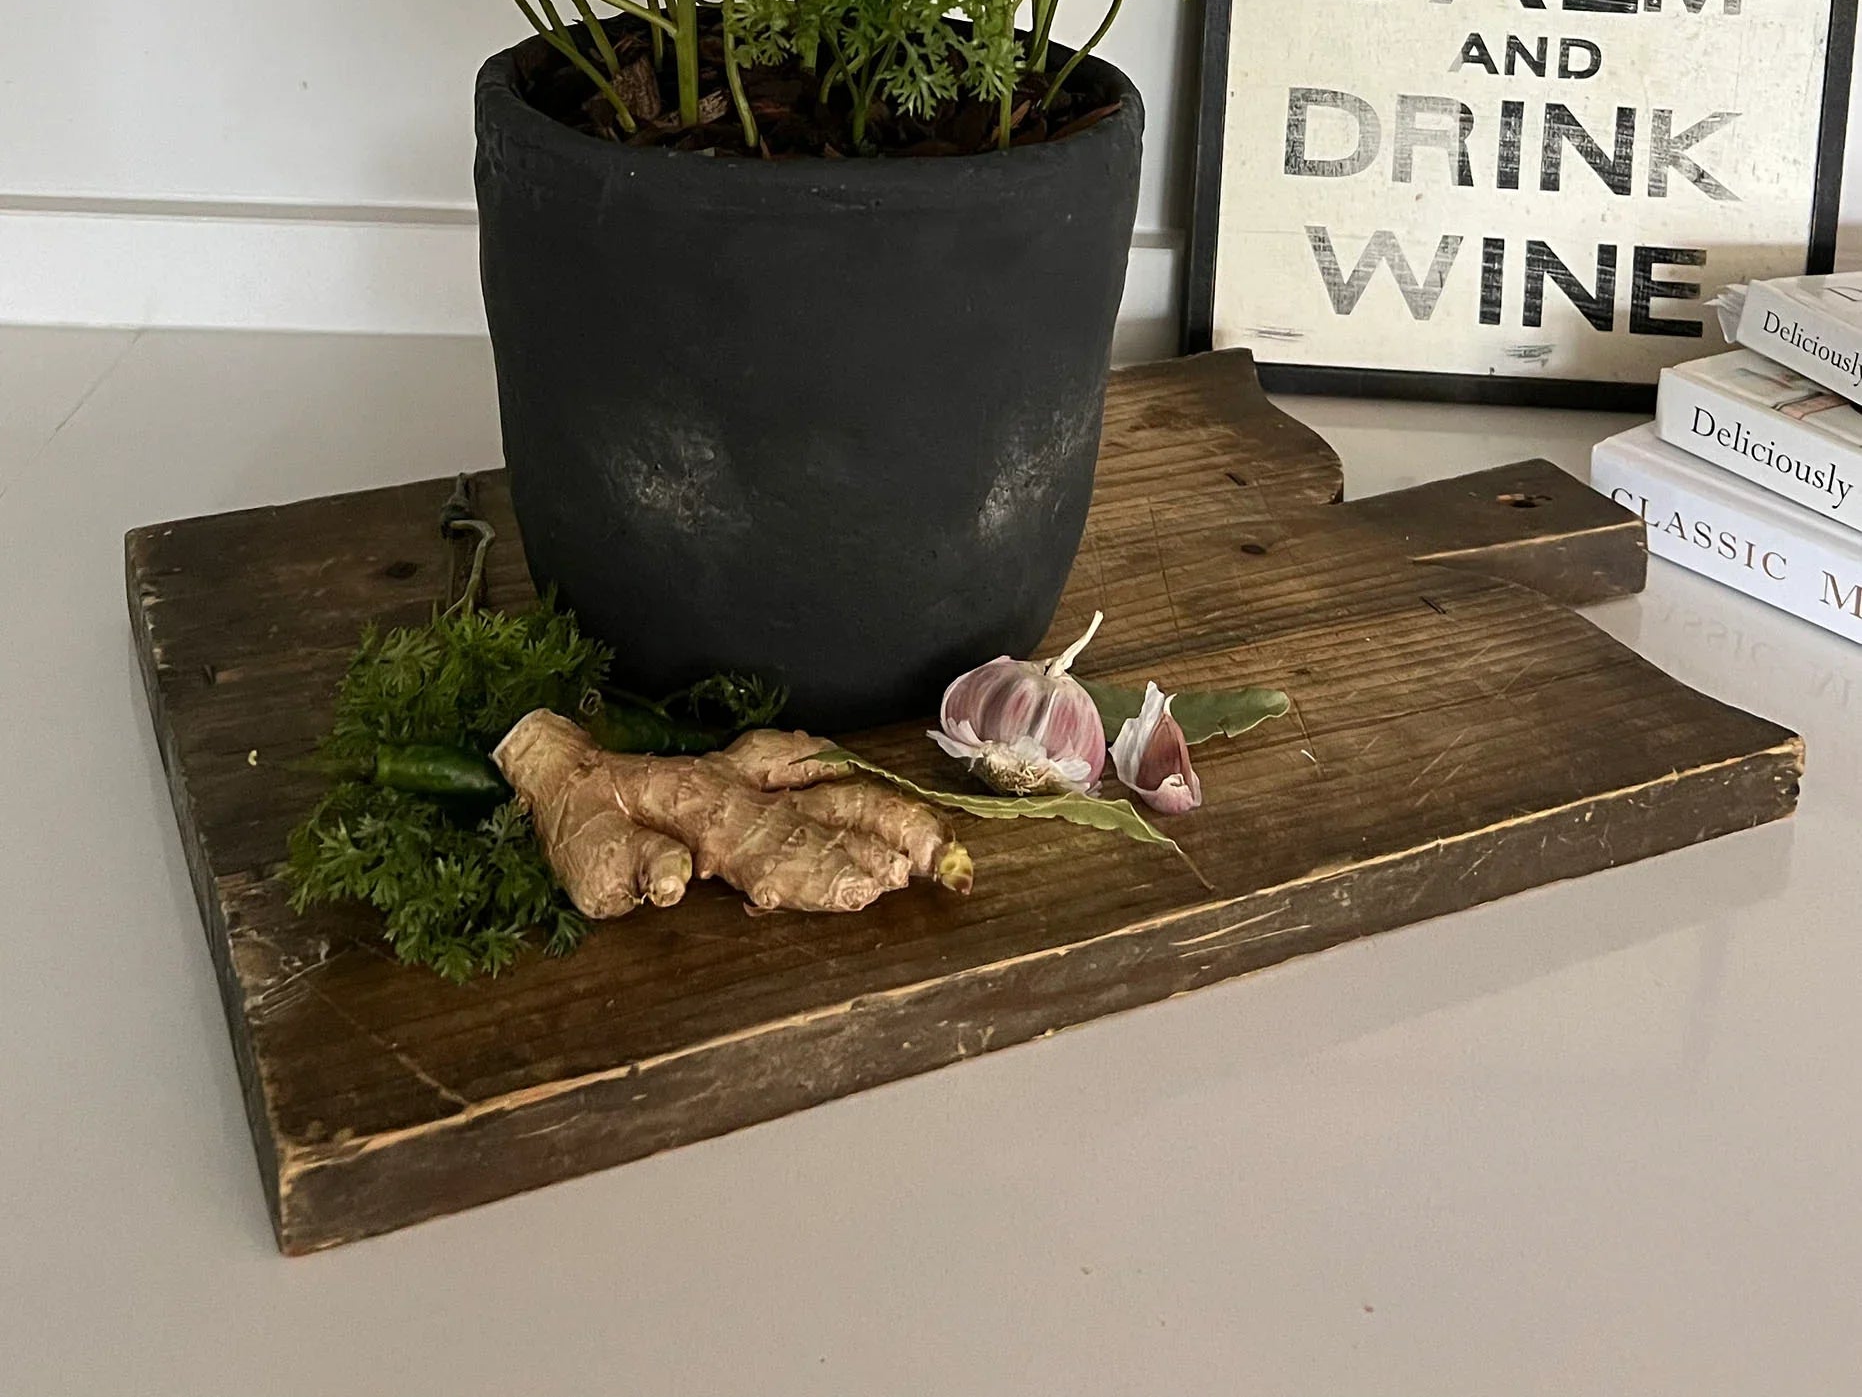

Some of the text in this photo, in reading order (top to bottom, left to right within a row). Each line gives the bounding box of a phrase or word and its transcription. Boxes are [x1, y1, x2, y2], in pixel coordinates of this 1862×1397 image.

[1448, 33, 1602, 79] AND
[1284, 87, 1744, 203] DRINK
[1306, 226, 1708, 338] WINE
[1691, 406, 1853, 508] Deliciously
[1611, 487, 1787, 580] CLASSIC
